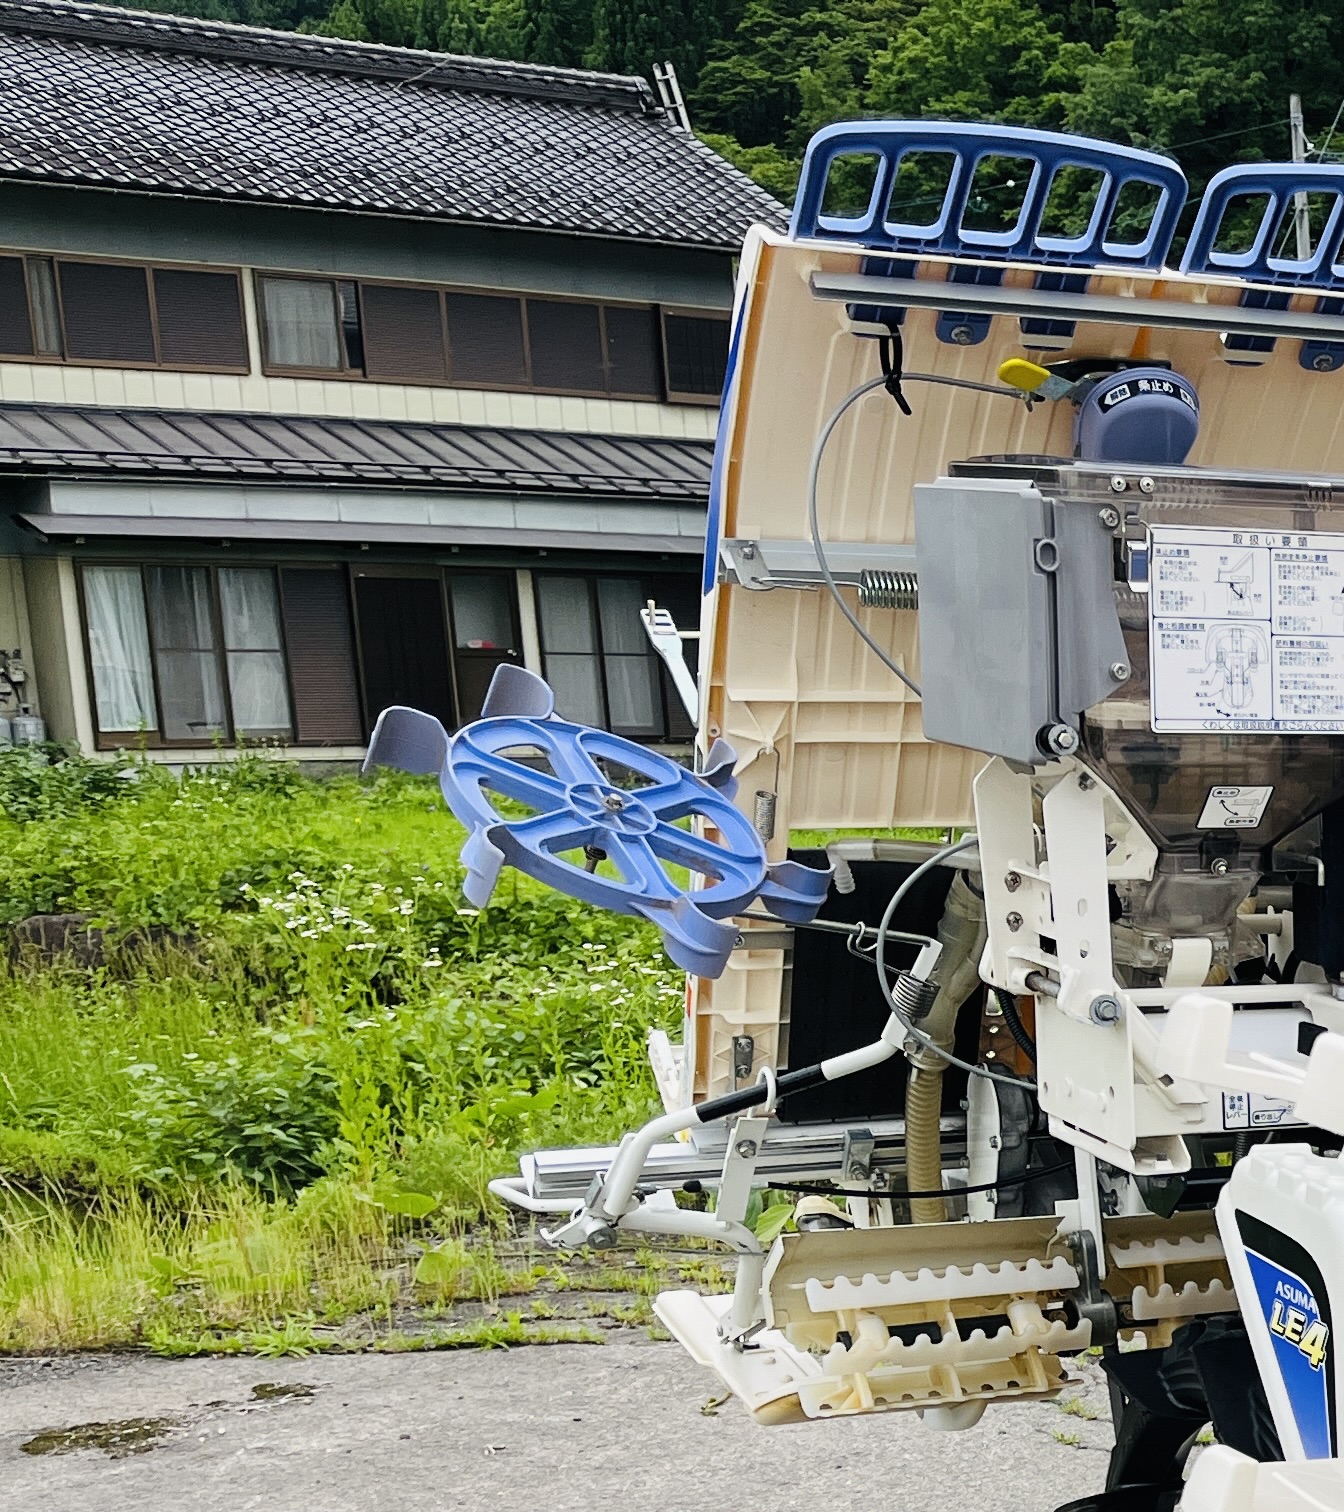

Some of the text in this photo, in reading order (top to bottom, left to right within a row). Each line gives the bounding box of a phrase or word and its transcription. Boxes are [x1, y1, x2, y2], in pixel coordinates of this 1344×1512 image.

[1138, 380, 1174, 393] 条止め
[1232, 533, 1308, 547] 取扱い要領
[1226, 1111, 1247, 1120] レバー
[1275, 1280, 1317, 1313] ASUMA
[1270, 1298, 1329, 1371] LE4
